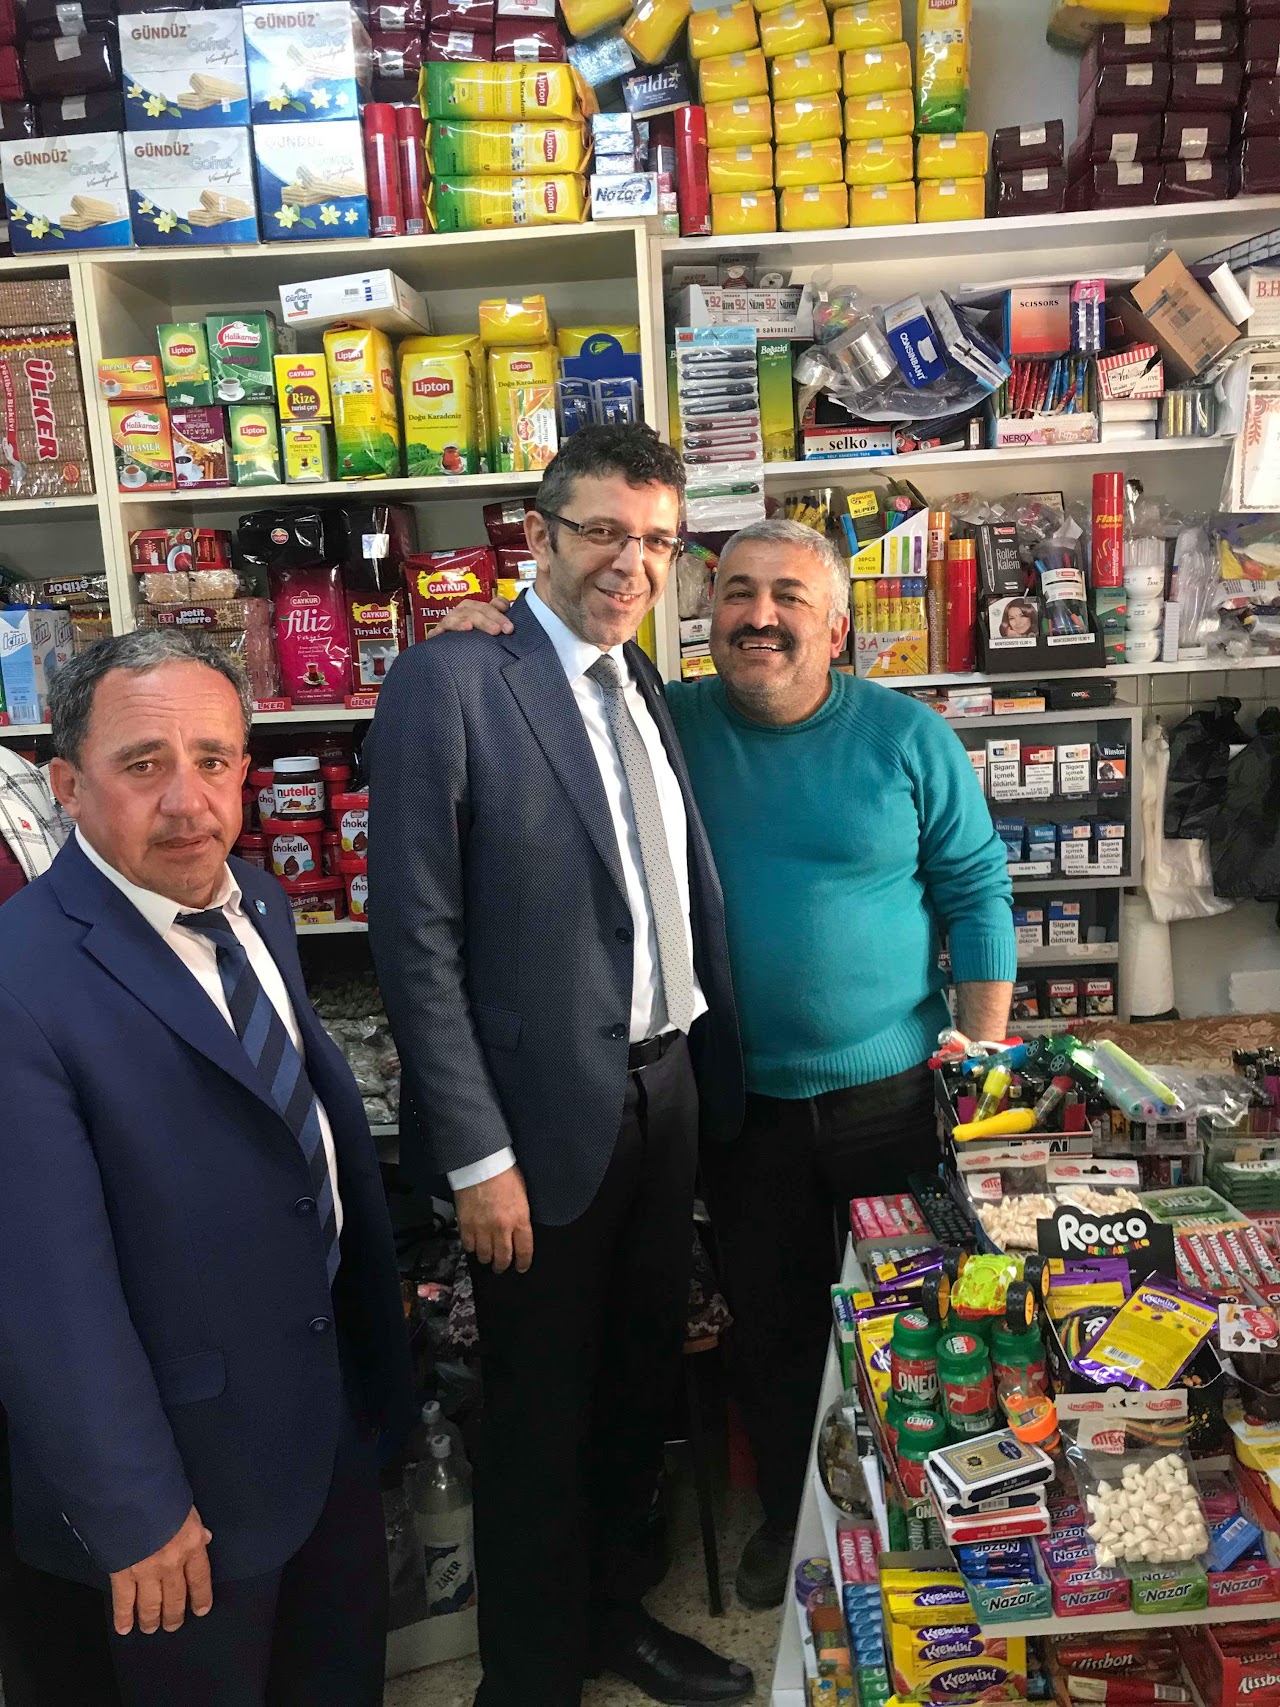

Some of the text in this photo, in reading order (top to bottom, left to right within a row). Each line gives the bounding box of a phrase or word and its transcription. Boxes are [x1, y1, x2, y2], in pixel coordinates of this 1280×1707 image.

[254, 12, 316, 29] GÜNDÜZ
[131, 25, 187, 40] GÜNDÜZ
[134, 143, 190, 159] GÜNDÜZ
[545, 131, 557, 161] Lipton
[13, 152, 68, 167] GÜNDÜZ
[546, 184, 557, 212] Lipton
[766, 298, 777, 309] 92
[1020, 300, 1059, 308] SCISSORS
[223, 332, 261, 342] Halikarnas
[171, 345, 194, 355] Lipton
[336, 349, 362, 363] Lipton
[511, 363, 532, 371] Lipton
[416, 378, 450, 394] Lipton
[292, 393, 316, 405] Rize
[24, 358, 59, 461] ÜLKER
[408, 412, 462, 422] Doğu Karadeniz
[126, 420, 160, 431] Halikarnas
[242, 427, 265, 435] Lipton
[829, 436, 868, 451] selko
[1002, 433, 1032, 446] NEROX
[854, 505, 876, 515] SUPER
[996, 549, 1017, 560] Roller
[997, 559, 1020, 570] Kalem
[180, 608, 204, 618] petit
[421, 607, 453, 618] Tiryak
[284, 608, 332, 640] filiz
[353, 627, 381, 637] Tiryaki
[858, 637, 879, 650] 3A
[351, 696, 378, 707] ÜLKE
[1071, 691, 1089, 699] nerox
[1104, 748, 1125, 756] Winston
[277, 786, 318, 798] nutella
[342, 819, 368, 829] choke
[273, 843, 310, 853] chokella
[1090, 982, 1109, 990] West
[1058, 1214, 1147, 1251] Rocco
[898, 1371, 938, 1393] ONEO
[974, 1541, 1021, 1554] Nazar
[1218, 1575, 1267, 1594] Nazar
[921, 1588, 967, 1605] Kremini
[1066, 1588, 1114, 1606] Nazar
[1144, 1583, 1192, 1602] Nazar
[989, 1590, 1035, 1612] Nazar
[923, 1626, 970, 1641] Kremini
[925, 1641, 973, 1659] Kremini
[940, 1668, 998, 1689] Kremini
